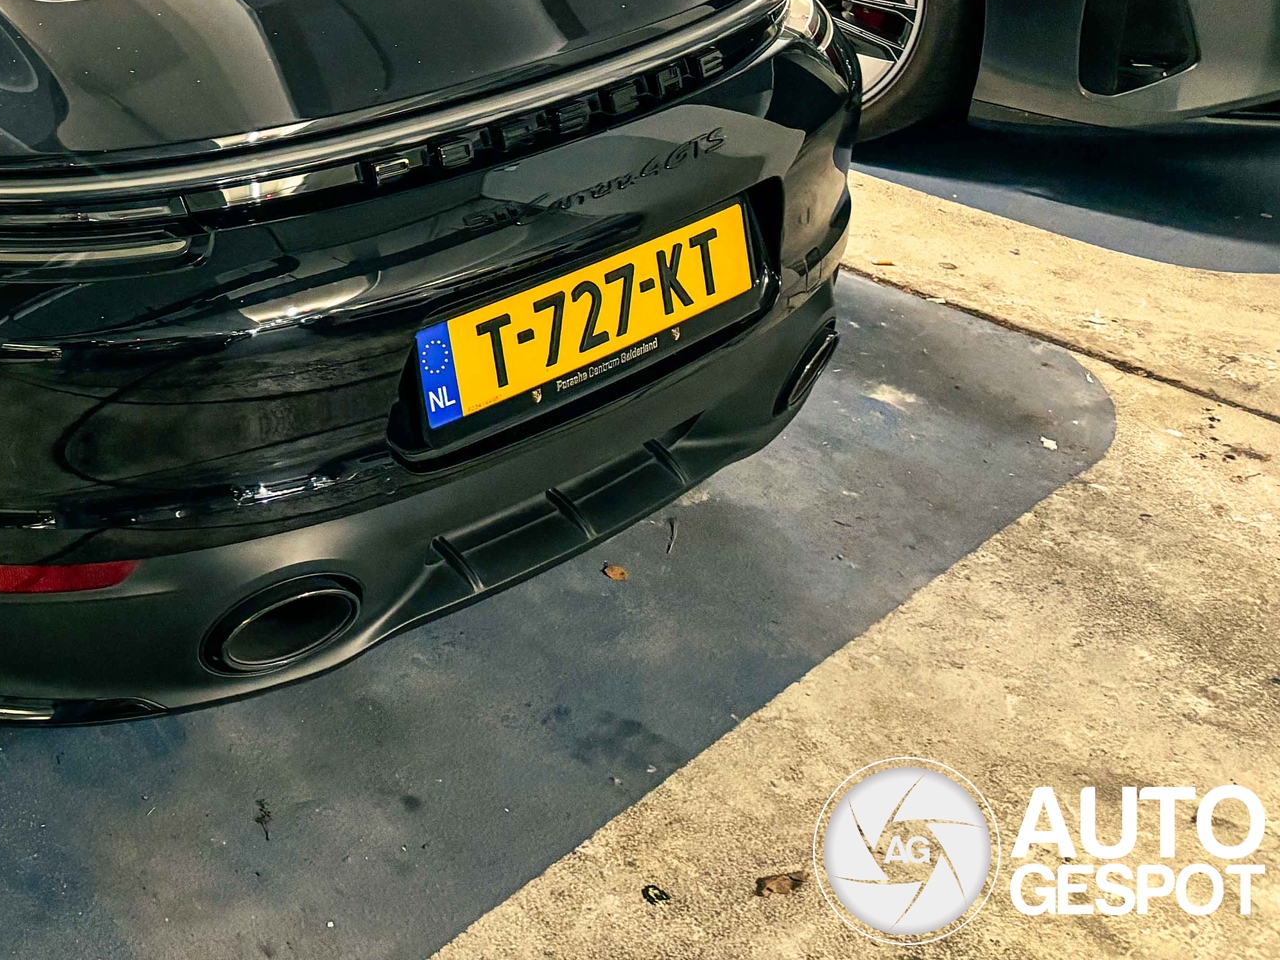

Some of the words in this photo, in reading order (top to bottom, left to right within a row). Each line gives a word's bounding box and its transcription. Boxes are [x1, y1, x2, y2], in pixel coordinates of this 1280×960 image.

[370, 47, 724, 187] PORSCHE
[475, 227, 718, 389] T-727-KT
[428, 386, 456, 413] NL
[556, 371, 588, 392] Porsche
[588, 357, 620, 378] Centrum
[620, 337, 659, 364] Gelderland
